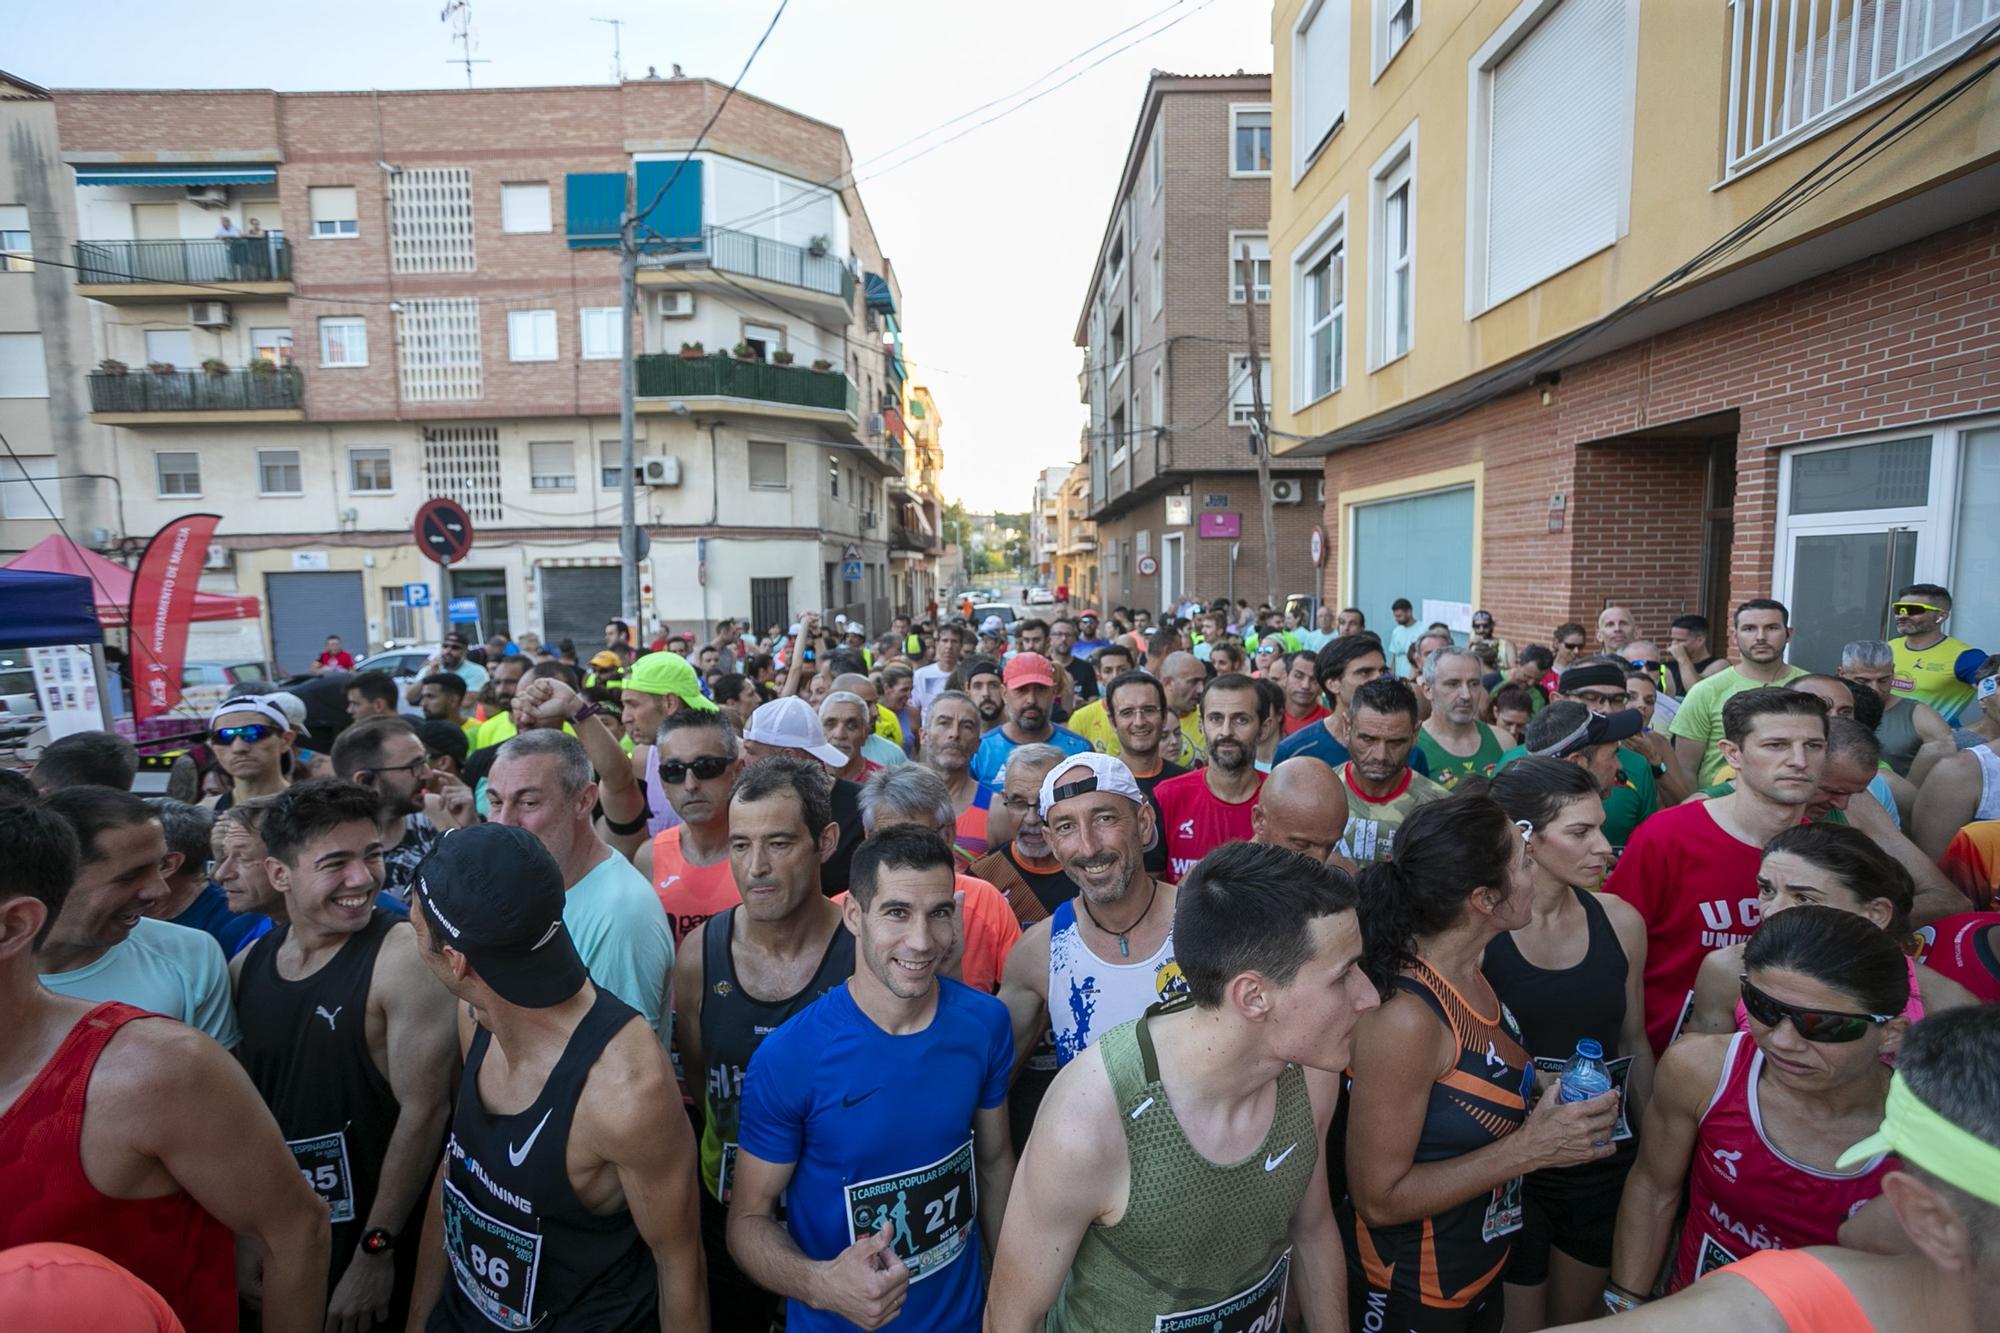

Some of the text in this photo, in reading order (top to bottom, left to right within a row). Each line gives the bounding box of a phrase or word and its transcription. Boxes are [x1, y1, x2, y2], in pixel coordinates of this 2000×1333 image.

[154, 527, 191, 652] AYUNTAMIENTO DE MURCIA
[408, 585, 426, 605] P
[428, 899, 461, 938] RUNNING
[293, 1139, 339, 1154] ESPINARDO
[852, 1191, 858, 1201] I
[857, 1182, 898, 1200] CARRERA
[899, 1171, 938, 1190] POPULAR
[938, 1148, 970, 1177] ESPINARDO
[924, 1185, 960, 1234] 27
[487, 1223, 534, 1250] ESPINARDO
[940, 1225, 958, 1240] NETA
[470, 1243, 510, 1288] 86
[480, 1282, 500, 1300] YUTE
[1170, 1312, 1216, 1331] CARRERA
[1218, 1294, 1257, 1319] POPULAR
